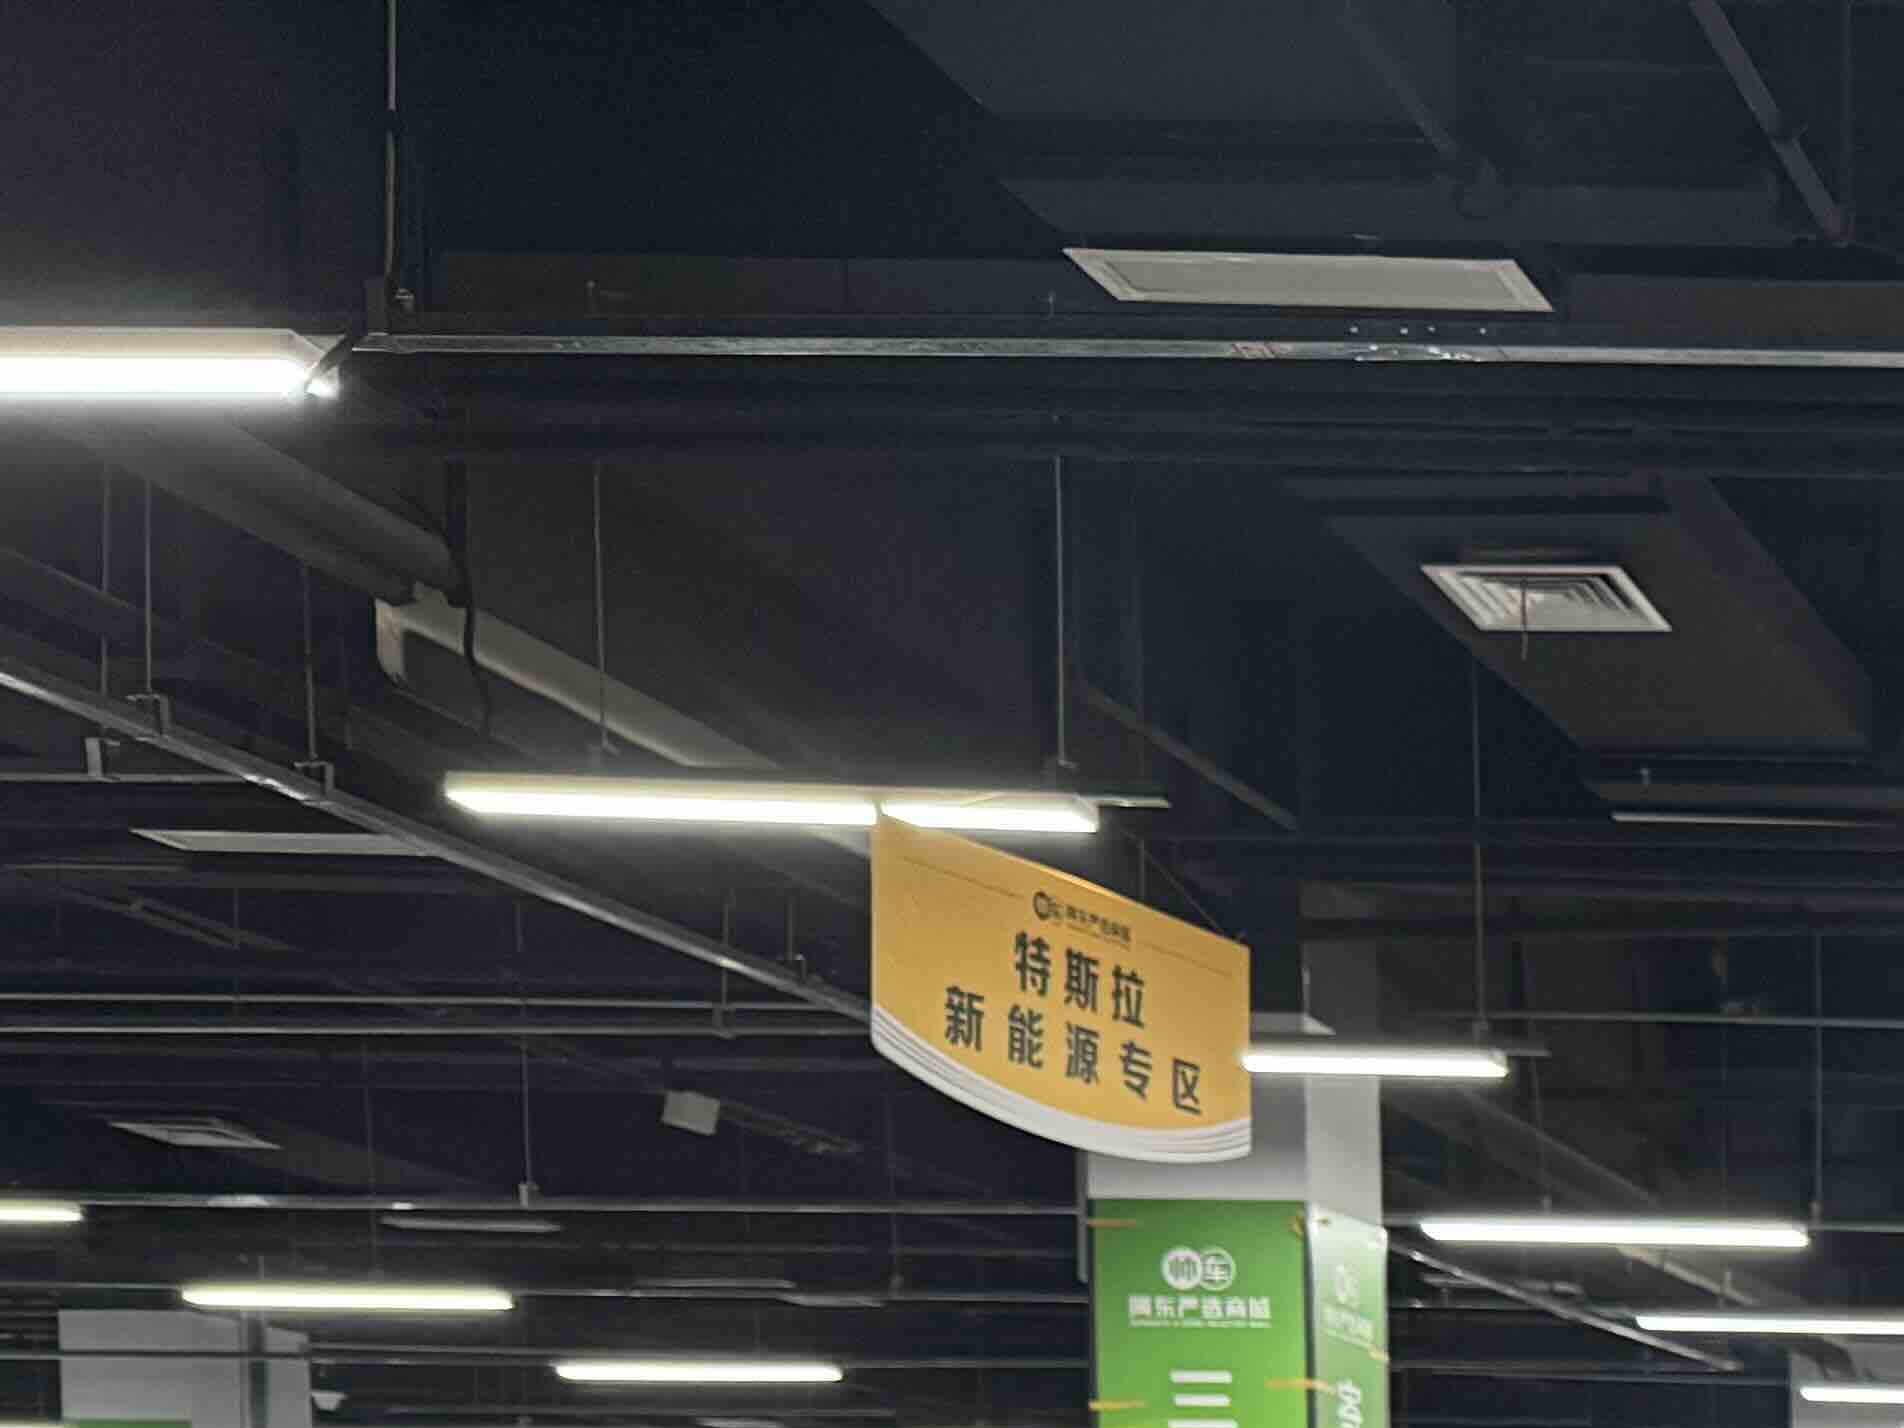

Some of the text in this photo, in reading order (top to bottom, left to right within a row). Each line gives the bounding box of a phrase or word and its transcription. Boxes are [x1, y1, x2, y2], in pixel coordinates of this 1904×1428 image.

[1014, 930, 1145, 1029] 特斯拉
[944, 985, 1202, 1116] 新能源专区
